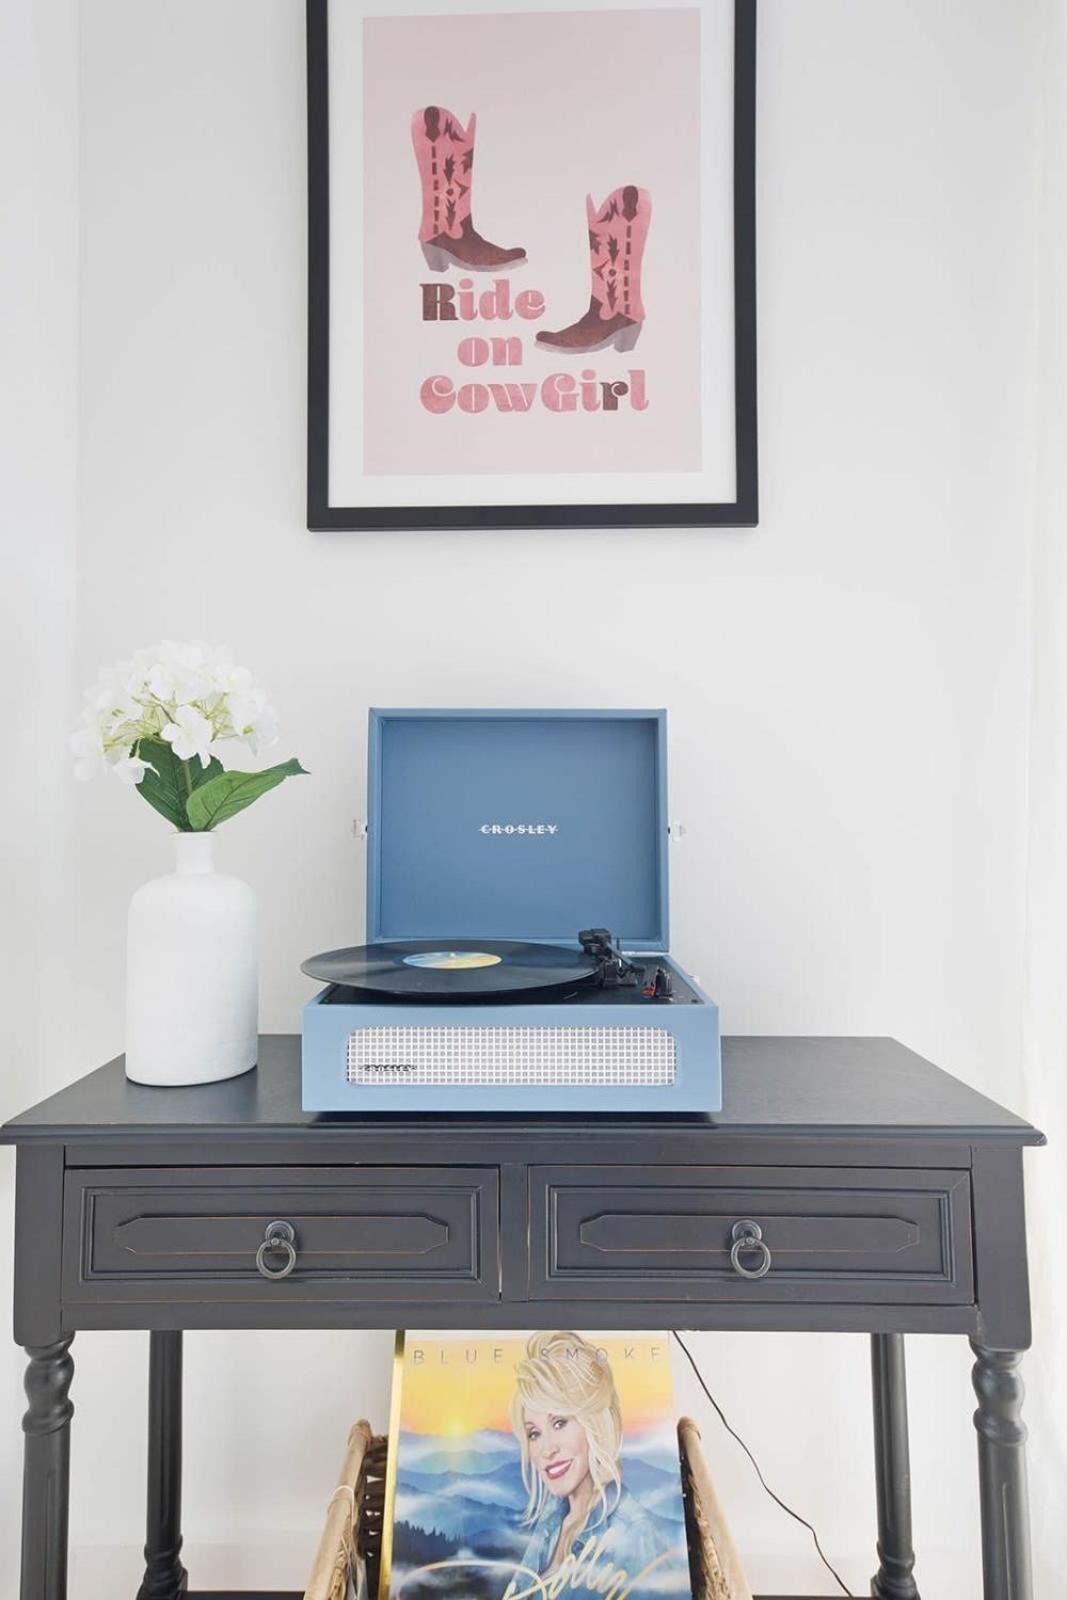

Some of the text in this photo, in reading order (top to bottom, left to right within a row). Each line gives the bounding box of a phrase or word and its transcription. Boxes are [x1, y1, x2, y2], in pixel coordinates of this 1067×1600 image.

[420, 278, 546, 321] Ride
[457, 336, 523, 367] on
[420, 369, 650, 414] CowGirl
[479, 824, 558, 834] CROSLEY
[413, 1346, 664, 1365] BLUE SMOKE
